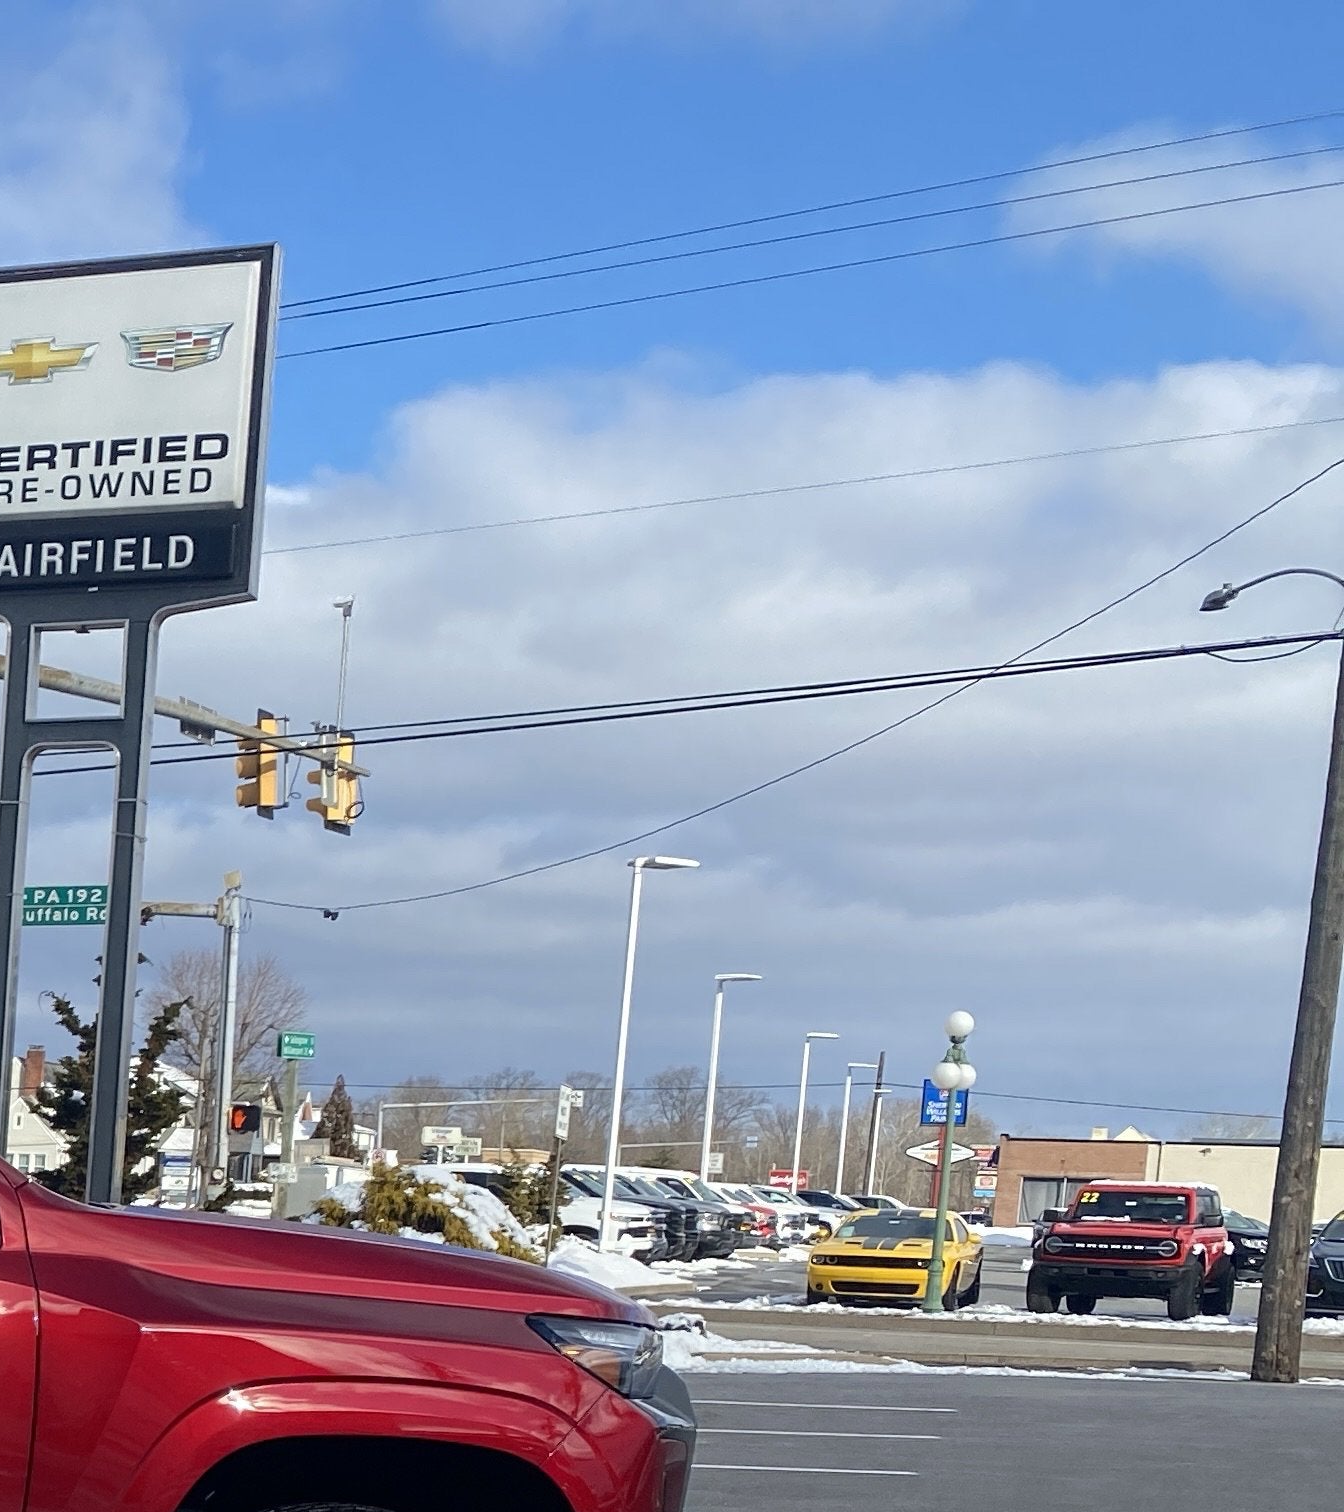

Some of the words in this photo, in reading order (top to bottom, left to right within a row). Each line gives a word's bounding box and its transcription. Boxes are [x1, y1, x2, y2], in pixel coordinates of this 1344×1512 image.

[33, 889, 60, 904] PA
[67, 888, 102, 903] 192
[24, 907, 79, 922] uffalo
[1080, 1192, 1100, 1203] 22
